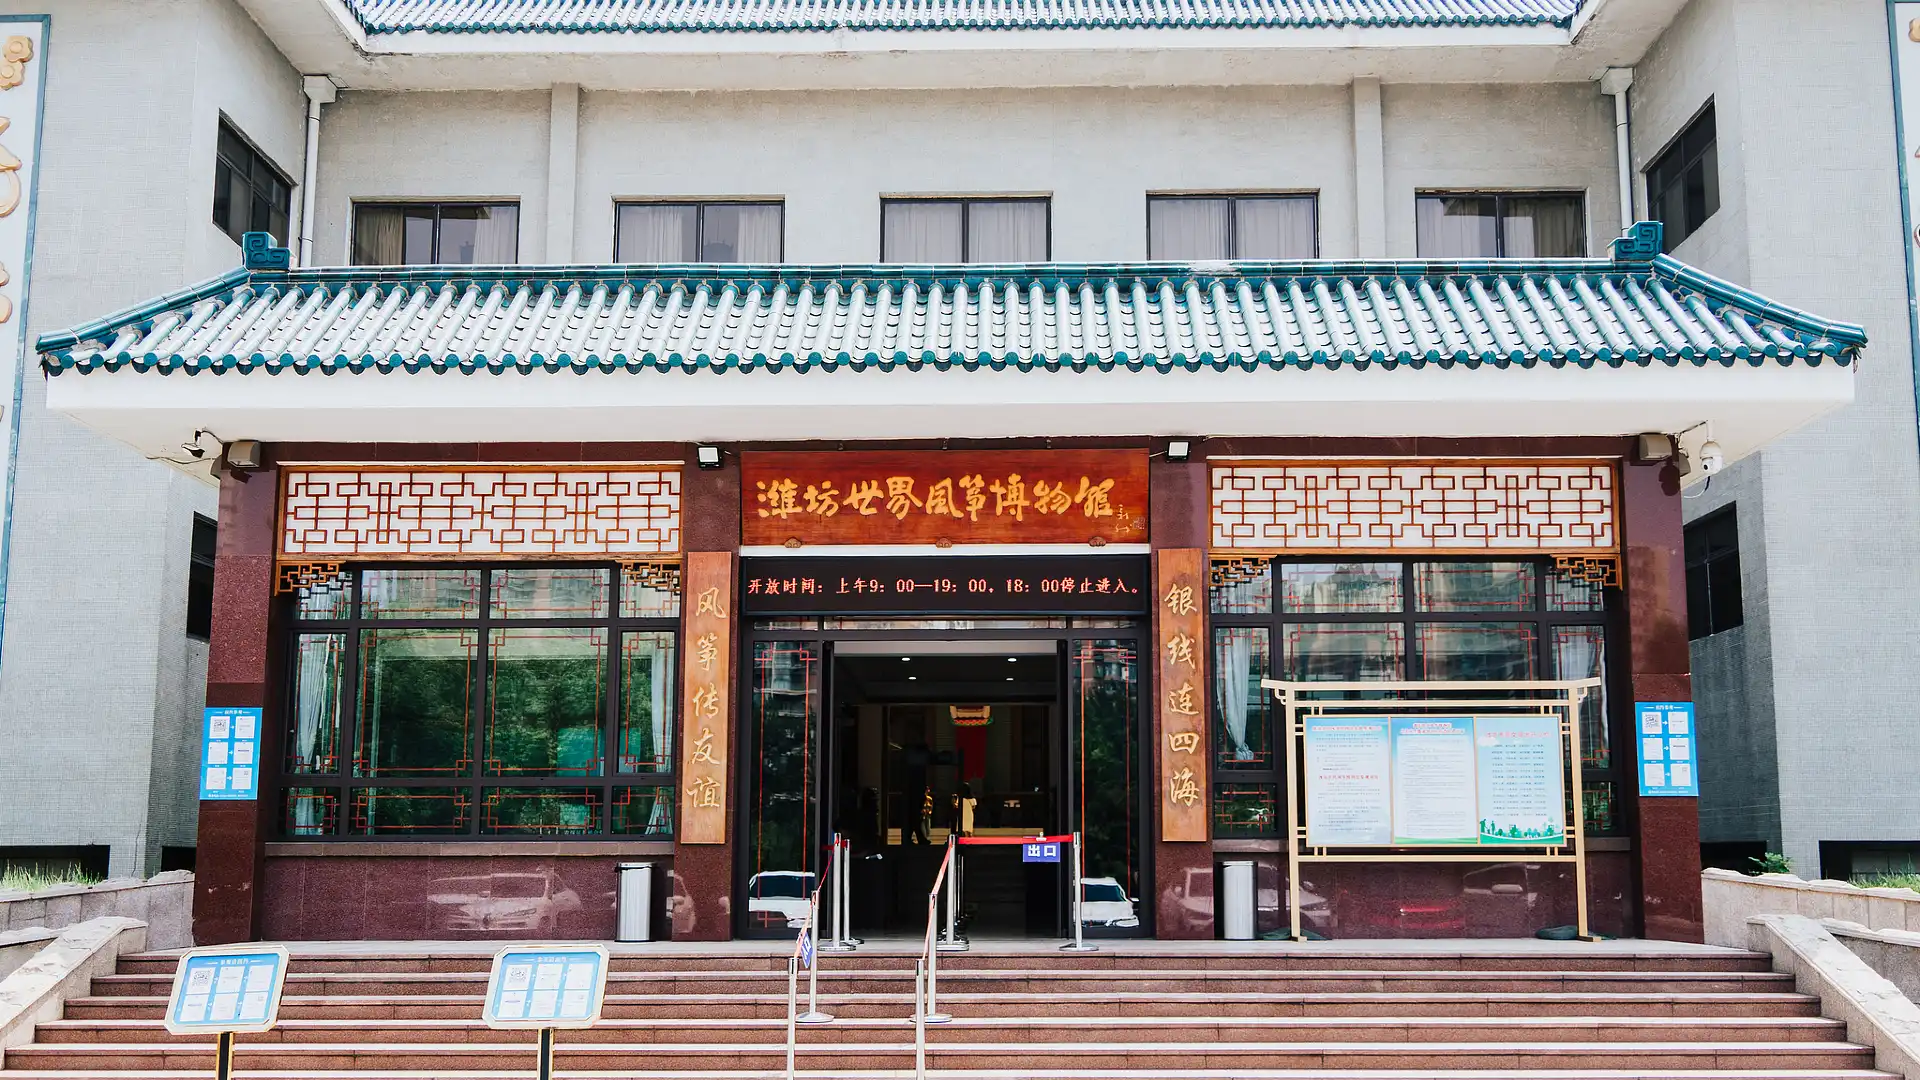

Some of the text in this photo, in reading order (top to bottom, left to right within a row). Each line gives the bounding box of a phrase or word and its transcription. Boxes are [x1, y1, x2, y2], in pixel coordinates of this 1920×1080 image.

[686, 586, 727, 808] 风筝传友谊
[1164, 583, 1200, 807] 银线连四海
[1028, 844, 1056, 857] 出口
